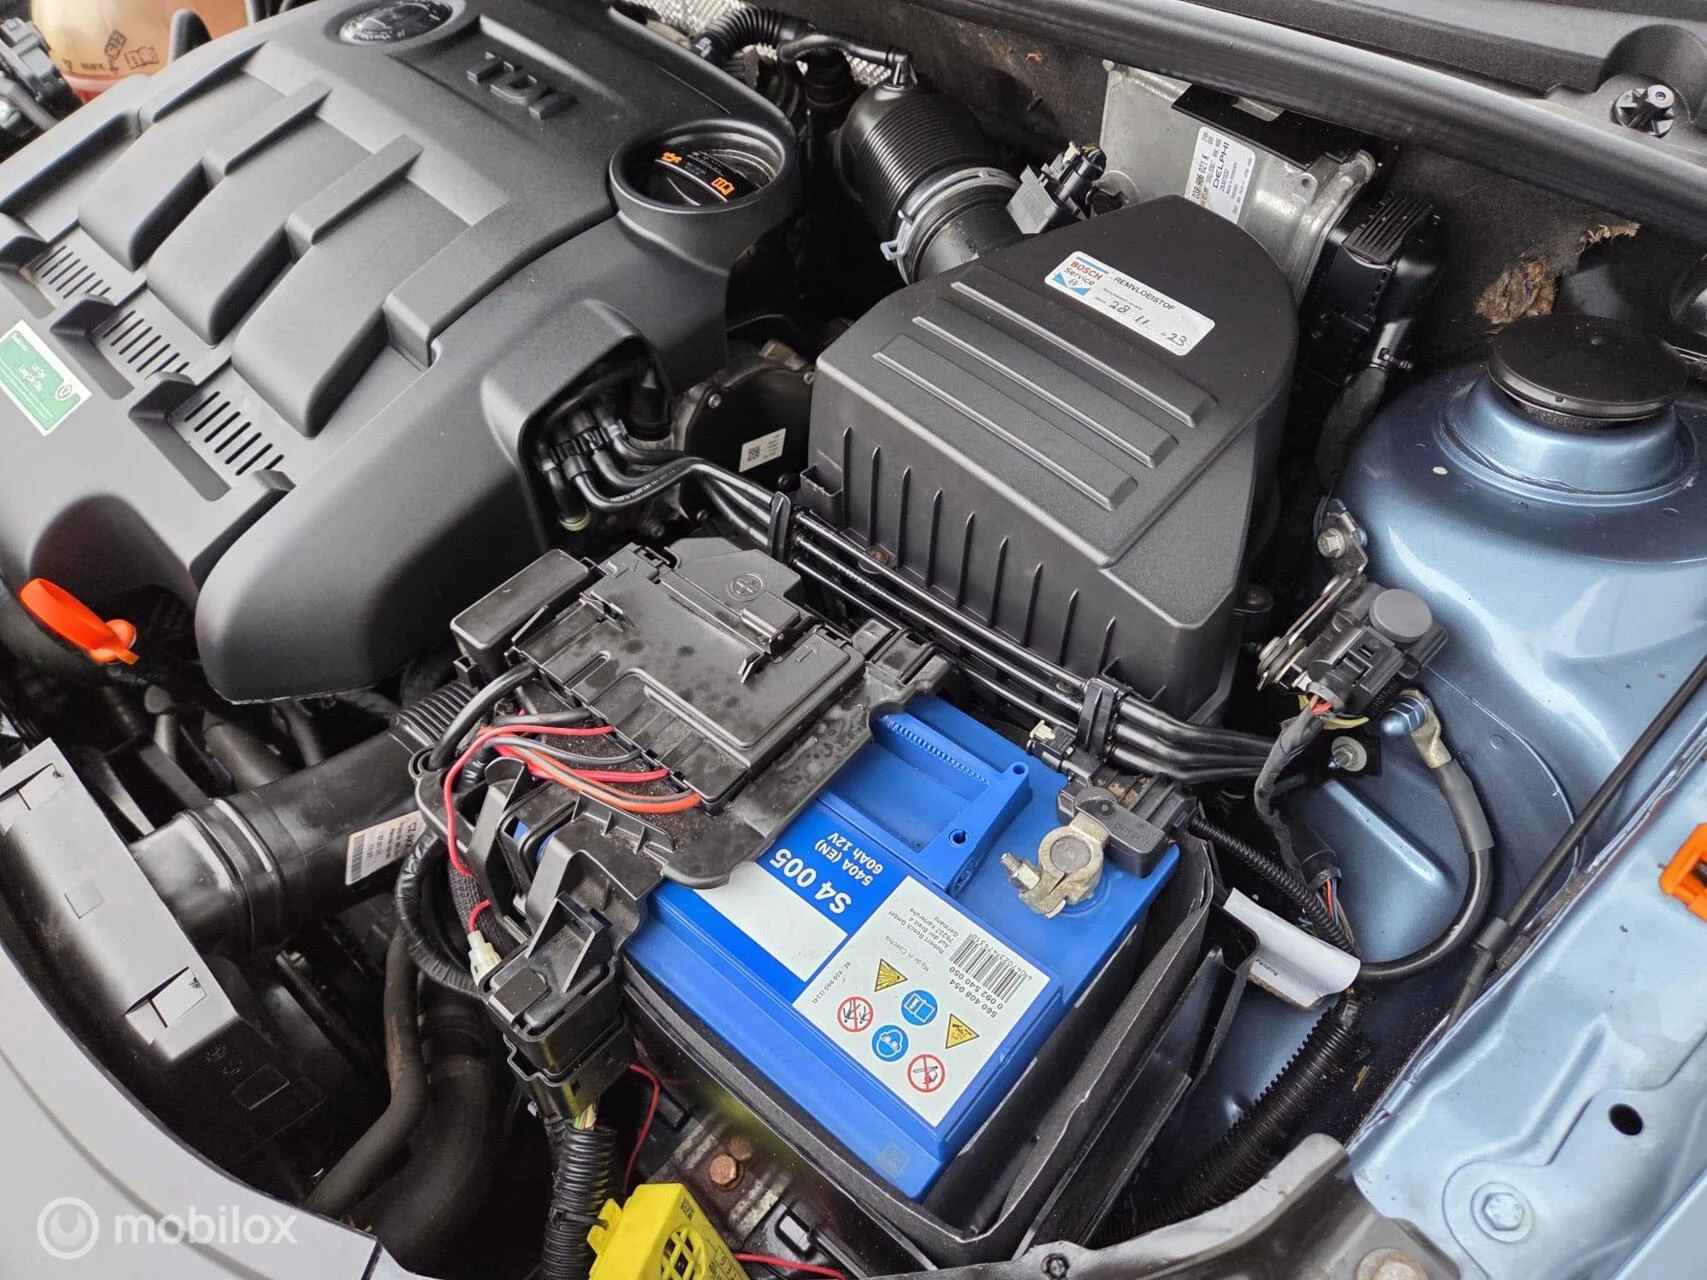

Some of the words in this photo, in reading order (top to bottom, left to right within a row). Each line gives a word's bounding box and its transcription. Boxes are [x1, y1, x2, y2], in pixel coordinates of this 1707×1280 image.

[466, 51, 580, 121] TDI
[1212, 141, 1229, 188] DELPHI
[1063, 267, 1095, 286] Service
[1070, 260, 1103, 280] BOSCH
[1113, 276, 1176, 311] REMVLOEISTOF
[1166, 332, 1188, 346] 23
[827, 832, 853, 852] 12V
[814, 839, 843, 863] (EN)
[770, 849, 817, 888] 005
[852, 848, 883, 874] 60Ah
[842, 859, 873, 886] 540A
[814, 881, 852, 914] S4
[888, 911, 908, 926] GmbH
[933, 916, 960, 937] Germany
[906, 924, 925, 939] Bosch
[927, 931, 939, 941] der
[924, 937, 945, 954] Robert
[937, 938, 949, 948] Auf
[913, 956, 932, 971] Made
[948, 965, 965, 980] 050
[949, 979, 966, 993] 054
[965, 991, 982, 1006] 408
[980, 990, 998, 1005] 092
[996, 1001, 1004, 1010] 0
[981, 1003, 998, 1018] 560
